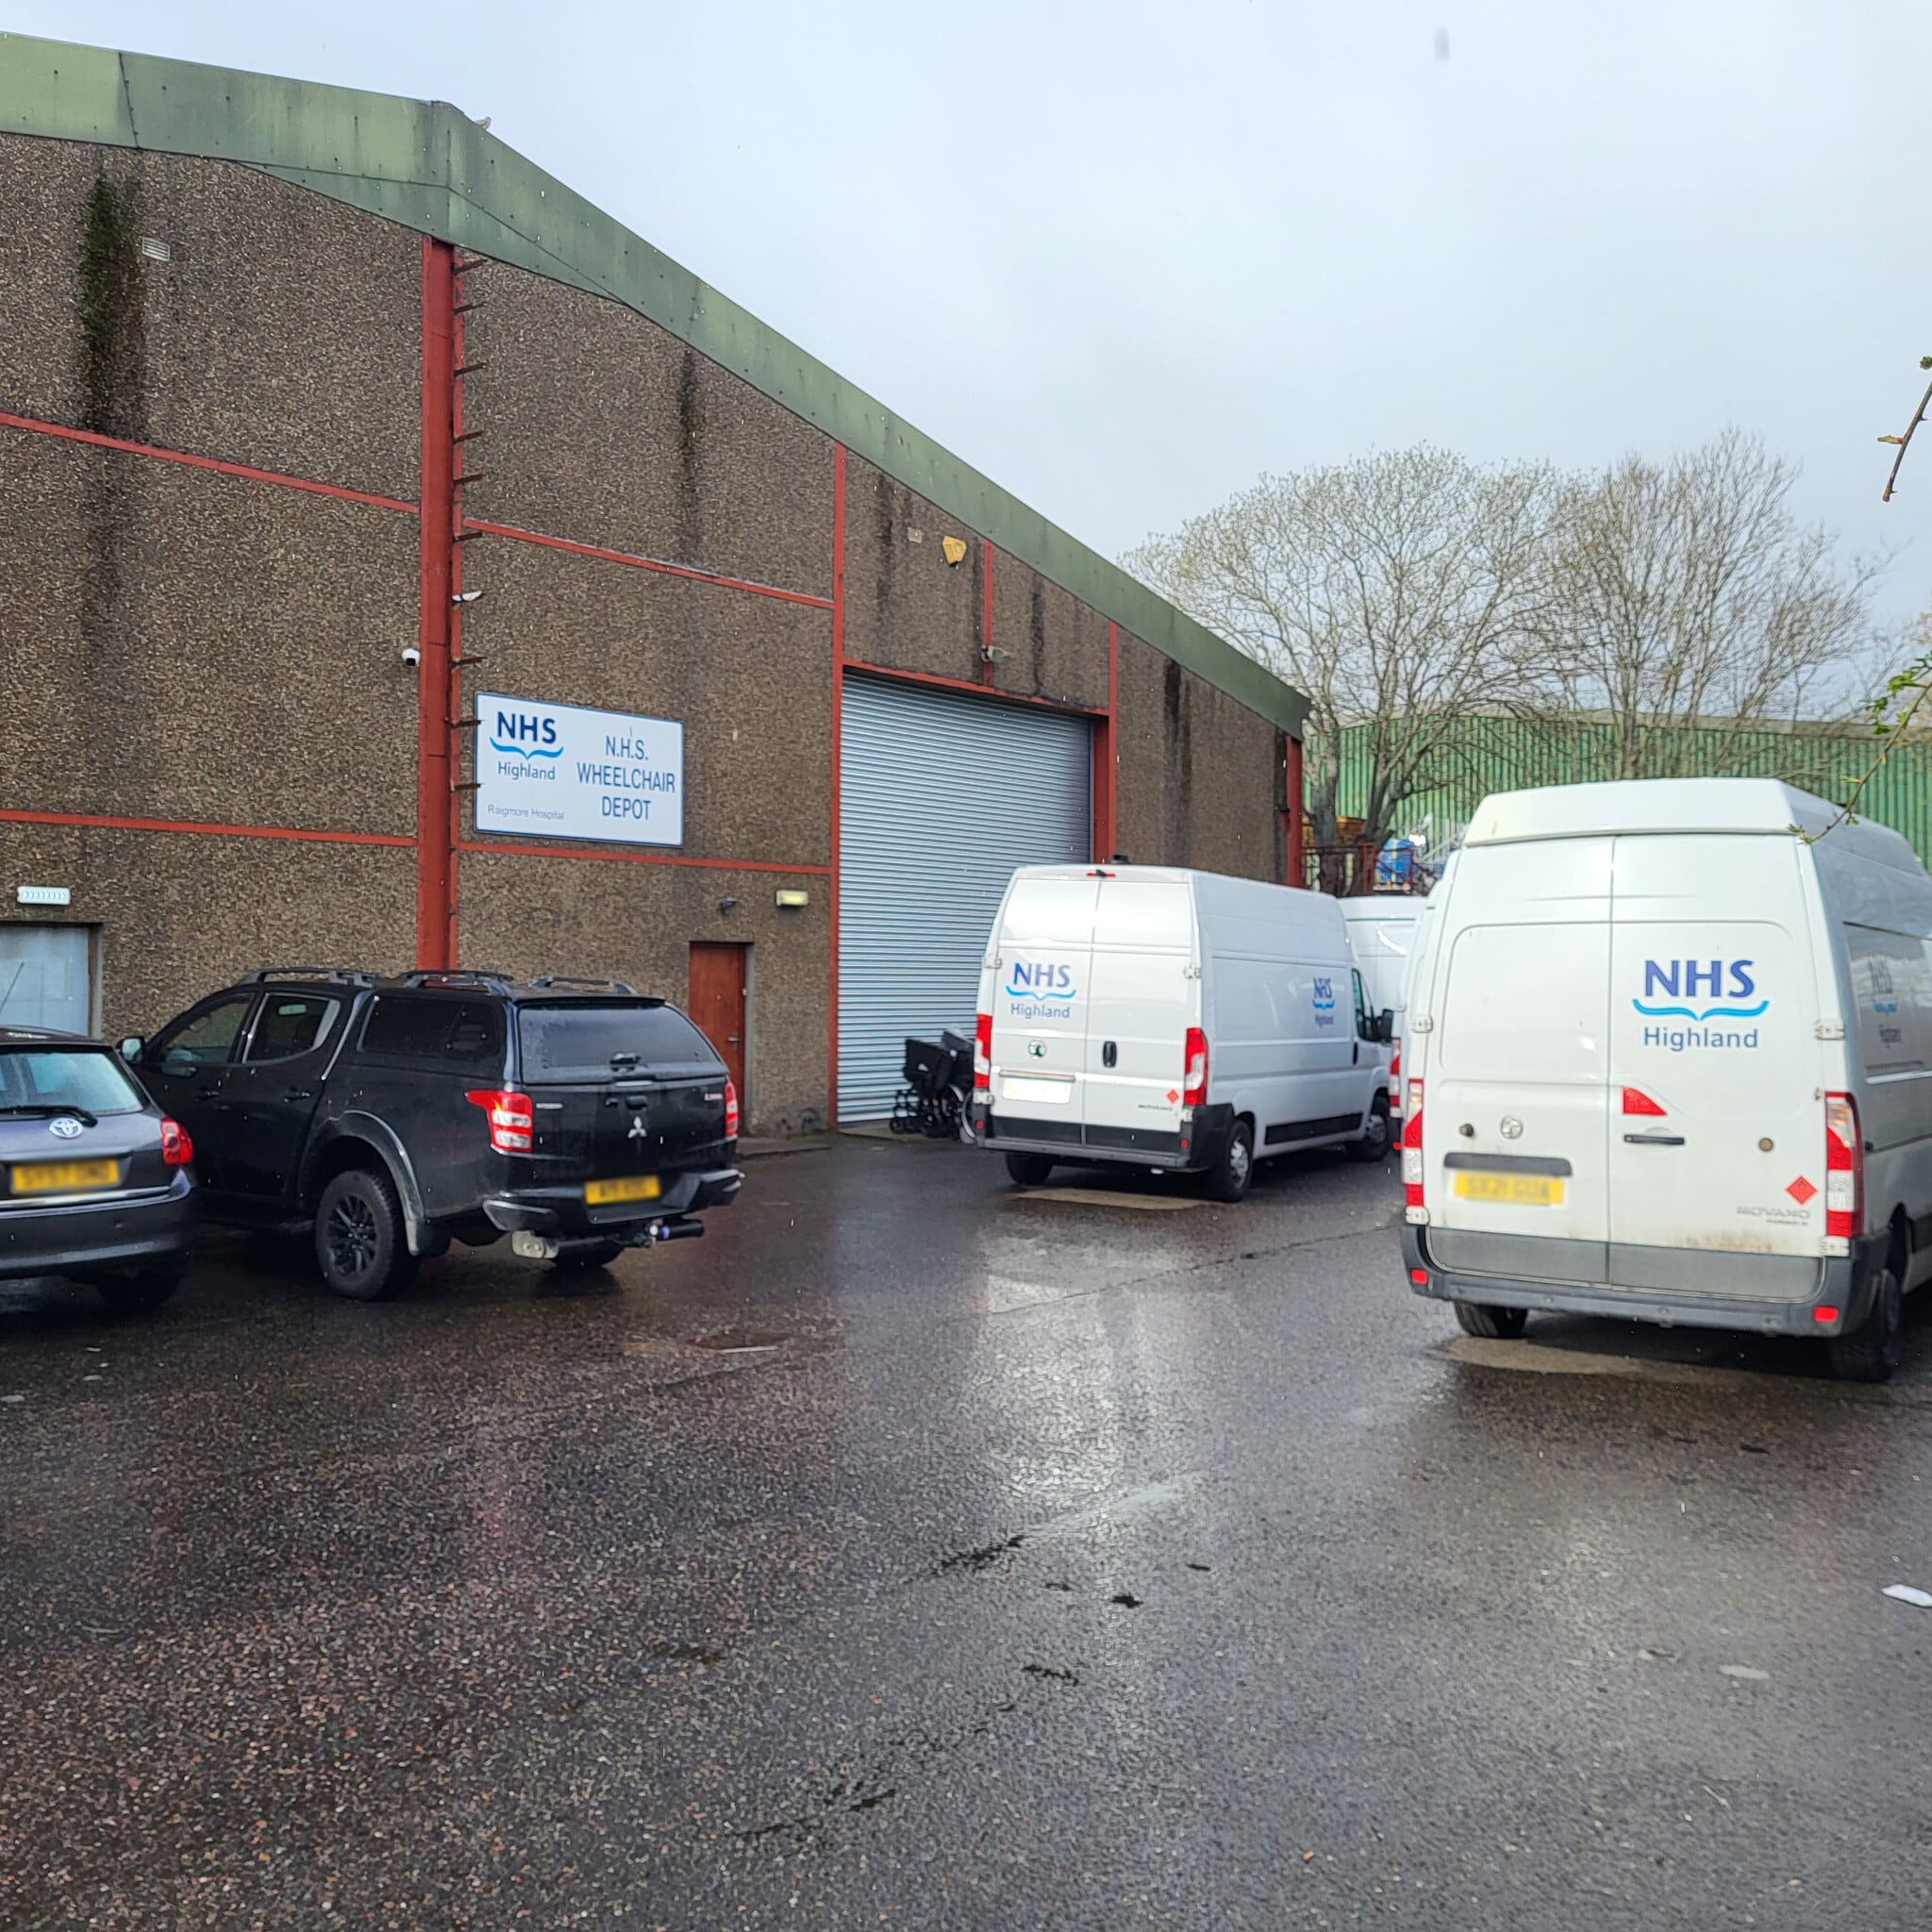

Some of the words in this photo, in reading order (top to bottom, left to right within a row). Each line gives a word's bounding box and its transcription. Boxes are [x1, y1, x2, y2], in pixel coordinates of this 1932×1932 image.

[497, 710, 557, 745] NHS
[605, 735, 649, 761] N.H.S.
[497, 760, 557, 781] Highland
[576, 761, 675, 793] WHEELCHAIR
[487, 804, 529, 817] Raigmore
[530, 808, 565, 820] Hospital
[602, 795, 652, 821] DEPOT
[1013, 962, 1072, 988] NHS
[1642, 959, 1756, 998] NHS
[1010, 1003, 1071, 1020] Highland
[1643, 1026, 1758, 1052] Highland
[1737, 1207, 1811, 1219] MOVANO
